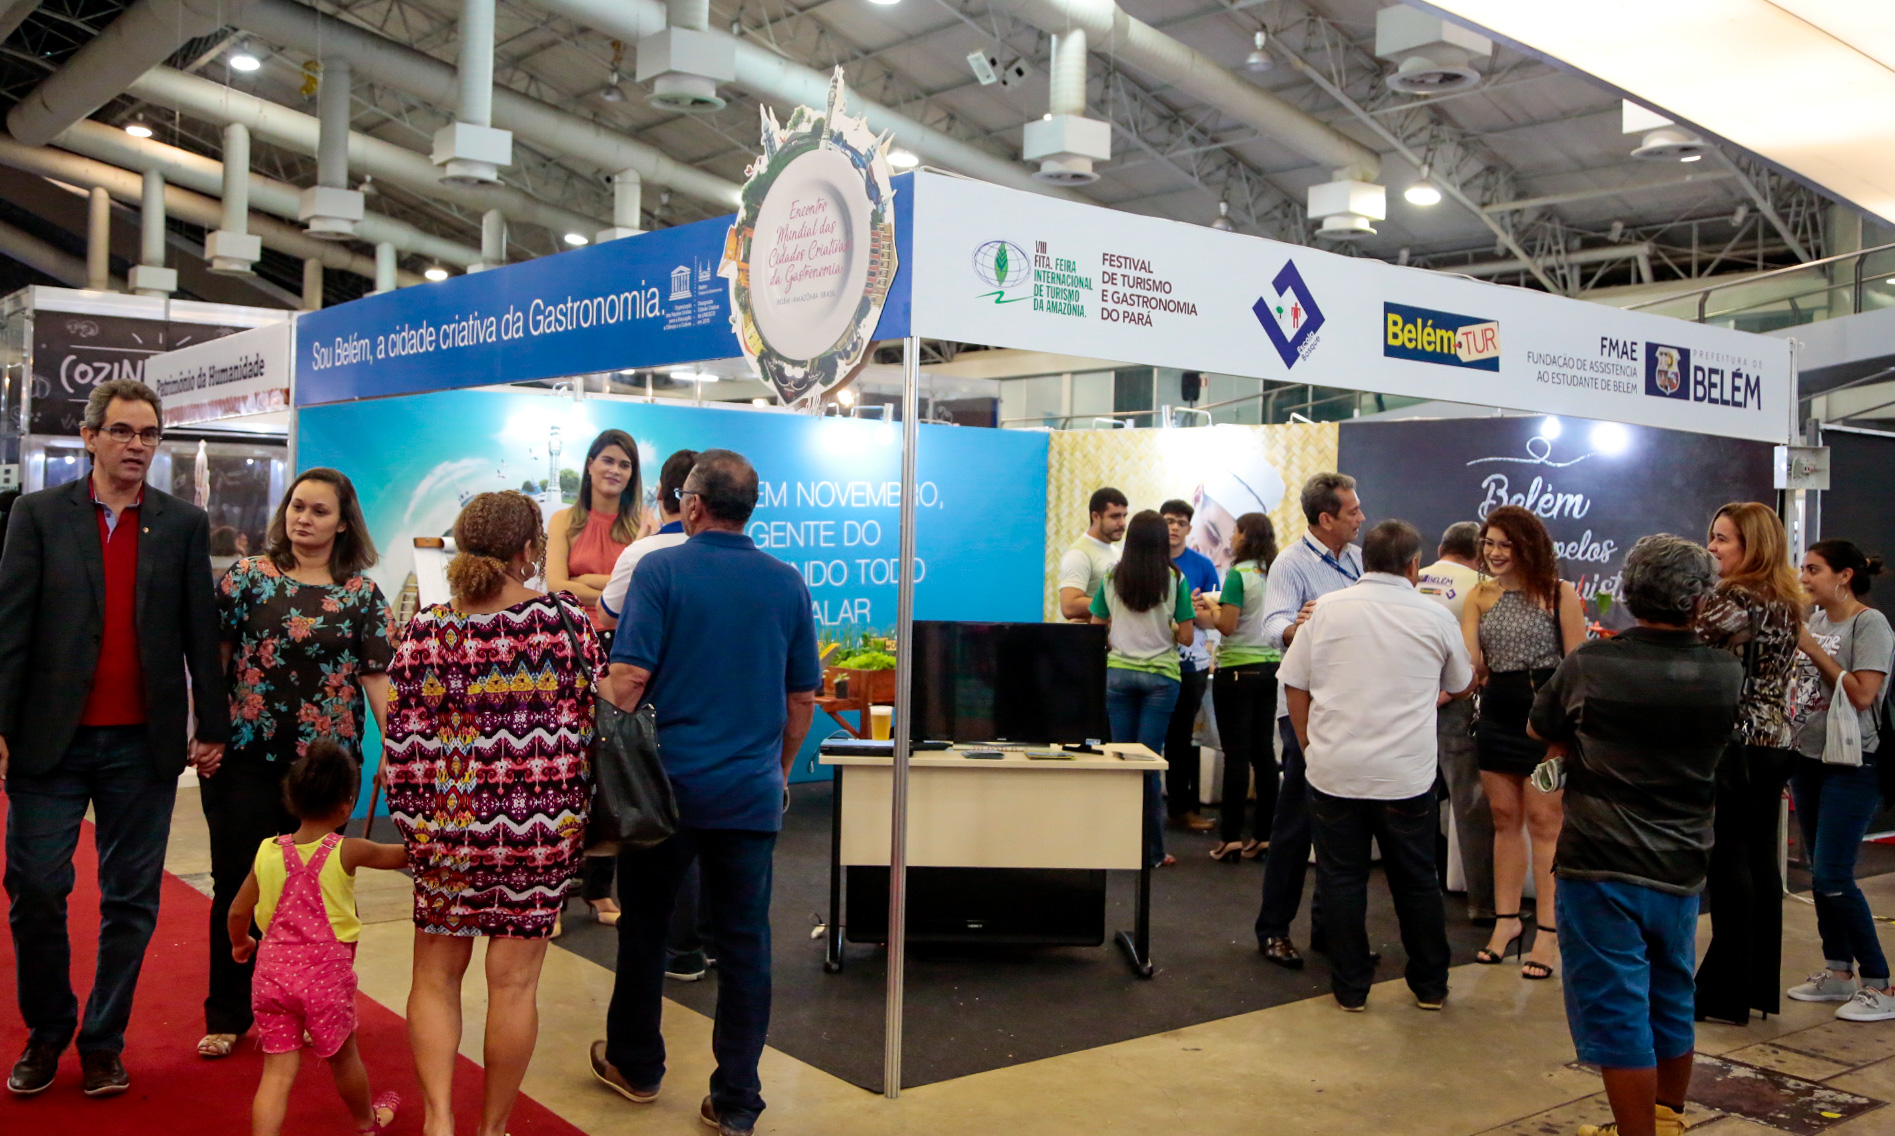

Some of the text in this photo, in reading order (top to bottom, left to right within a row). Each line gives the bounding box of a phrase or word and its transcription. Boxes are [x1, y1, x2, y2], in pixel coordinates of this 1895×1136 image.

[790, 198, 828, 220] Encontro
[777, 216, 836, 245] Mundial das
[769, 244, 805, 268] Cidades
[1036, 240, 1047, 254] VIII
[1034, 254, 1076, 274] FITA. FEIRA
[1102, 252, 1154, 274] FESTIVAL
[770, 263, 844, 294] da Gastronomia
[1034, 269, 1093, 290] INTERNACIONAL
[1102, 271, 1172, 294] DE TURISMO
[1034, 284, 1080, 302] DE TURISMO
[1102, 290, 1198, 316] E GASTRONOMIA
[1034, 298, 1087, 318] DA AMAZÔNIA.
[1101, 307, 1153, 327] DO PARÁ
[312, 342, 332, 370] Sou
[334, 332, 373, 366] Belém,
[376, 336, 386, 360] a
[388, 320, 436, 358] cidade
[440, 311, 496, 350] criativa
[501, 304, 524, 340] da
[529, 280, 665, 336] Gastronomia.
[1301, 336, 1320, 362] Bosque
[1600, 336, 1638, 362] FMAE
[1693, 350, 1762, 370] PREFEITURA DE
[156, 352, 265, 397] Patrimônio da Humanidade
[1527, 351, 1638, 378] FUNDAÇÃO DE ASSISTÊNCIA
[1537, 371, 1638, 394] AO ESTUDANTE DE BELÉM
[1693, 365, 1761, 410] BELÉM
[797, 480, 944, 510] NOVEMBO,
[1478, 473, 1590, 522] Belém
[748, 520, 882, 549] GENTE DO
[856, 557, 926, 584] TODO
[812, 598, 871, 626] ALAR
